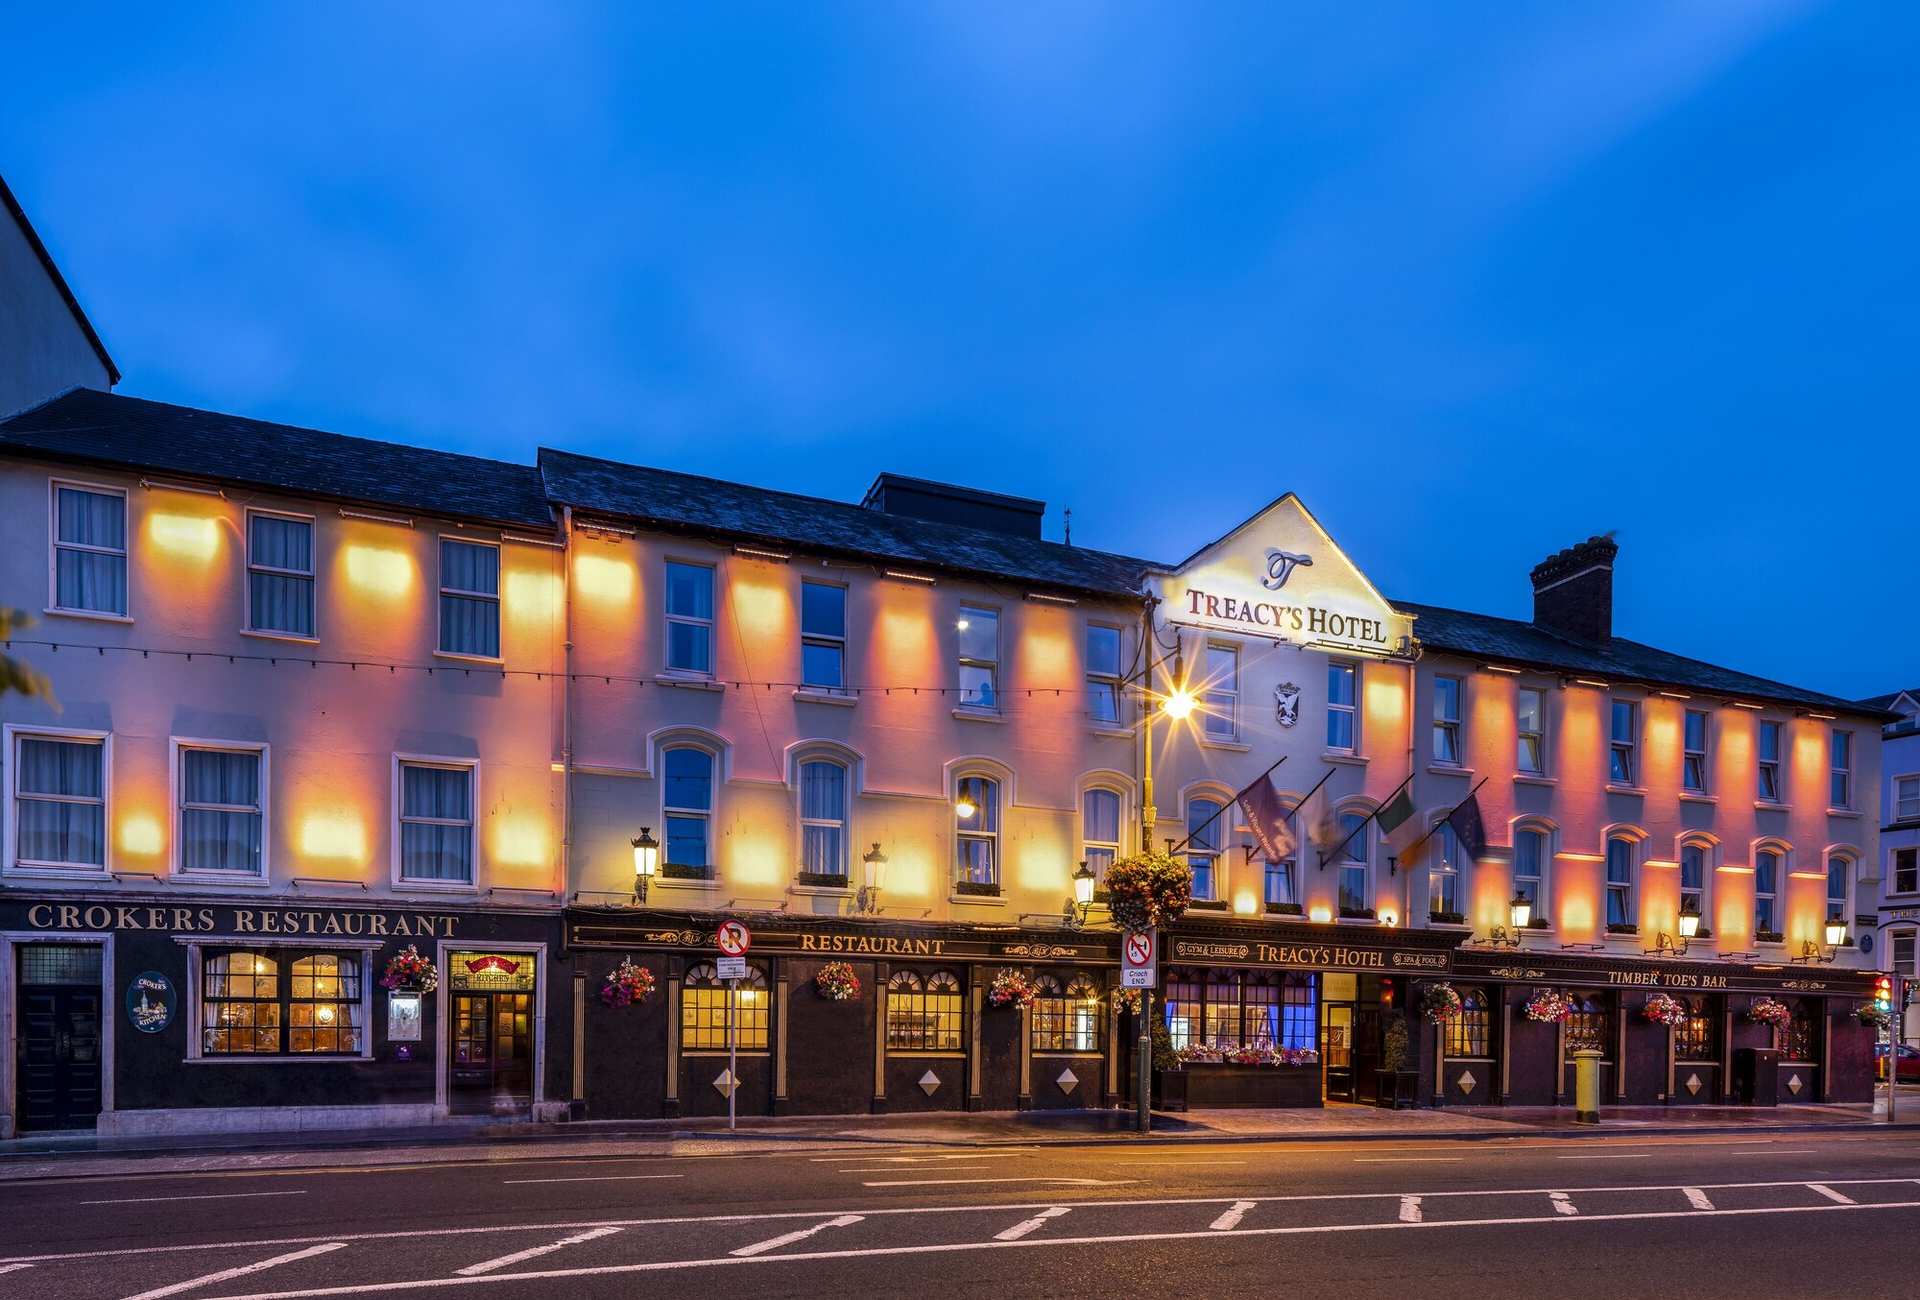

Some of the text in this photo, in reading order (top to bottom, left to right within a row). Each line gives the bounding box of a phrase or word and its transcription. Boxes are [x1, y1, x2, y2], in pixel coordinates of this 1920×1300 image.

[1186, 589, 1387, 643] TREACY'S HOTEL
[28, 904, 460, 937] CROKERS RESTAURANT
[801, 934, 945, 954] RESTAURANT
[1186, 945, 1203, 954] GYM
[1210, 946, 1239, 955] LEISURE
[1257, 944, 1385, 967] TREACY'S HOTEL
[1403, 955, 1415, 963] SPA
[1422, 956, 1438, 964] POOL
[1131, 977, 1146, 985] END
[1608, 971, 1728, 988] TIMBER TOE'S BAR
